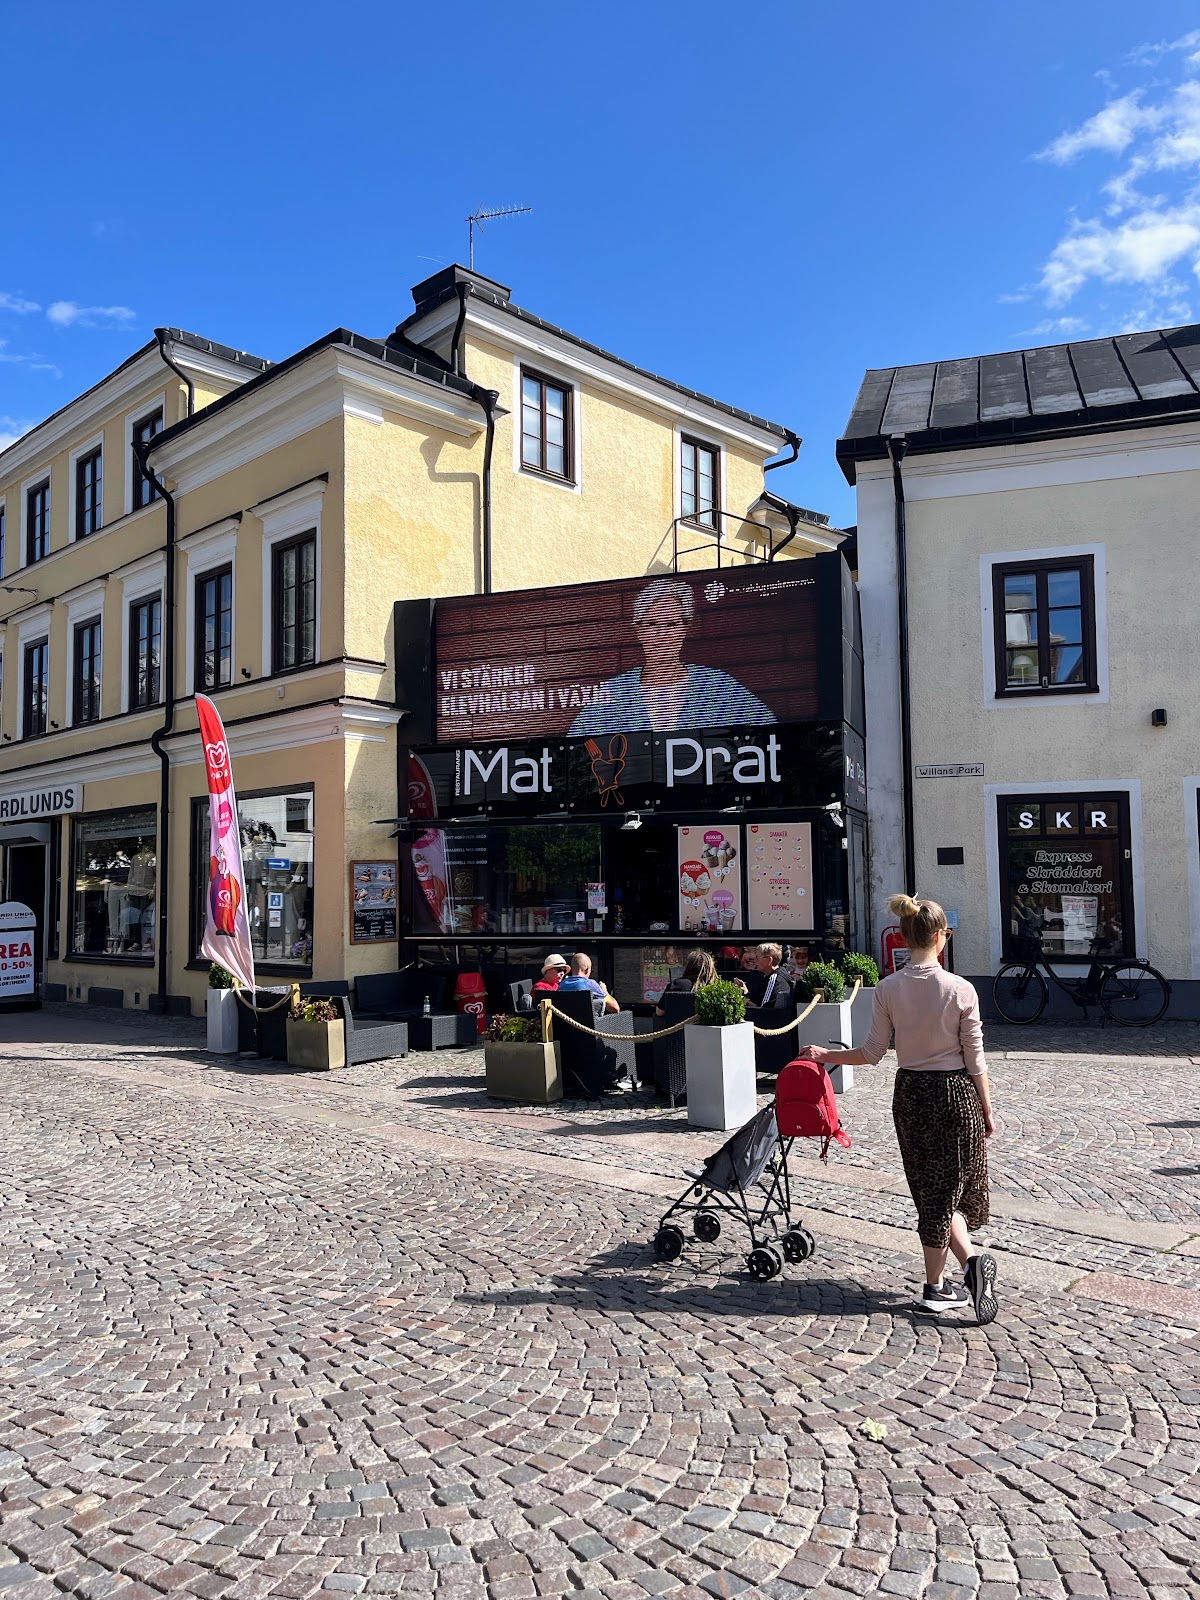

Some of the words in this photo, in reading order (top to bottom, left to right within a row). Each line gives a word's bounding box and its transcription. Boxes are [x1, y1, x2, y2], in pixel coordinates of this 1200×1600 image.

[441, 670, 458, 690] VI
[461, 664, 536, 688] STÄRKER
[666, 734, 781, 788] Prat
[464, 748, 552, 795] Mat
[958, 766, 981, 774] Park
[1, 788, 74, 817] RDLUNDS
[1035, 850, 1092, 865] Express
[1026, 866, 1102, 879] Skrädderi
[1018, 884, 1028, 893] &
[1031, 880, 1112, 894] Skomakeri
[0, 942, 32, 959] REA
